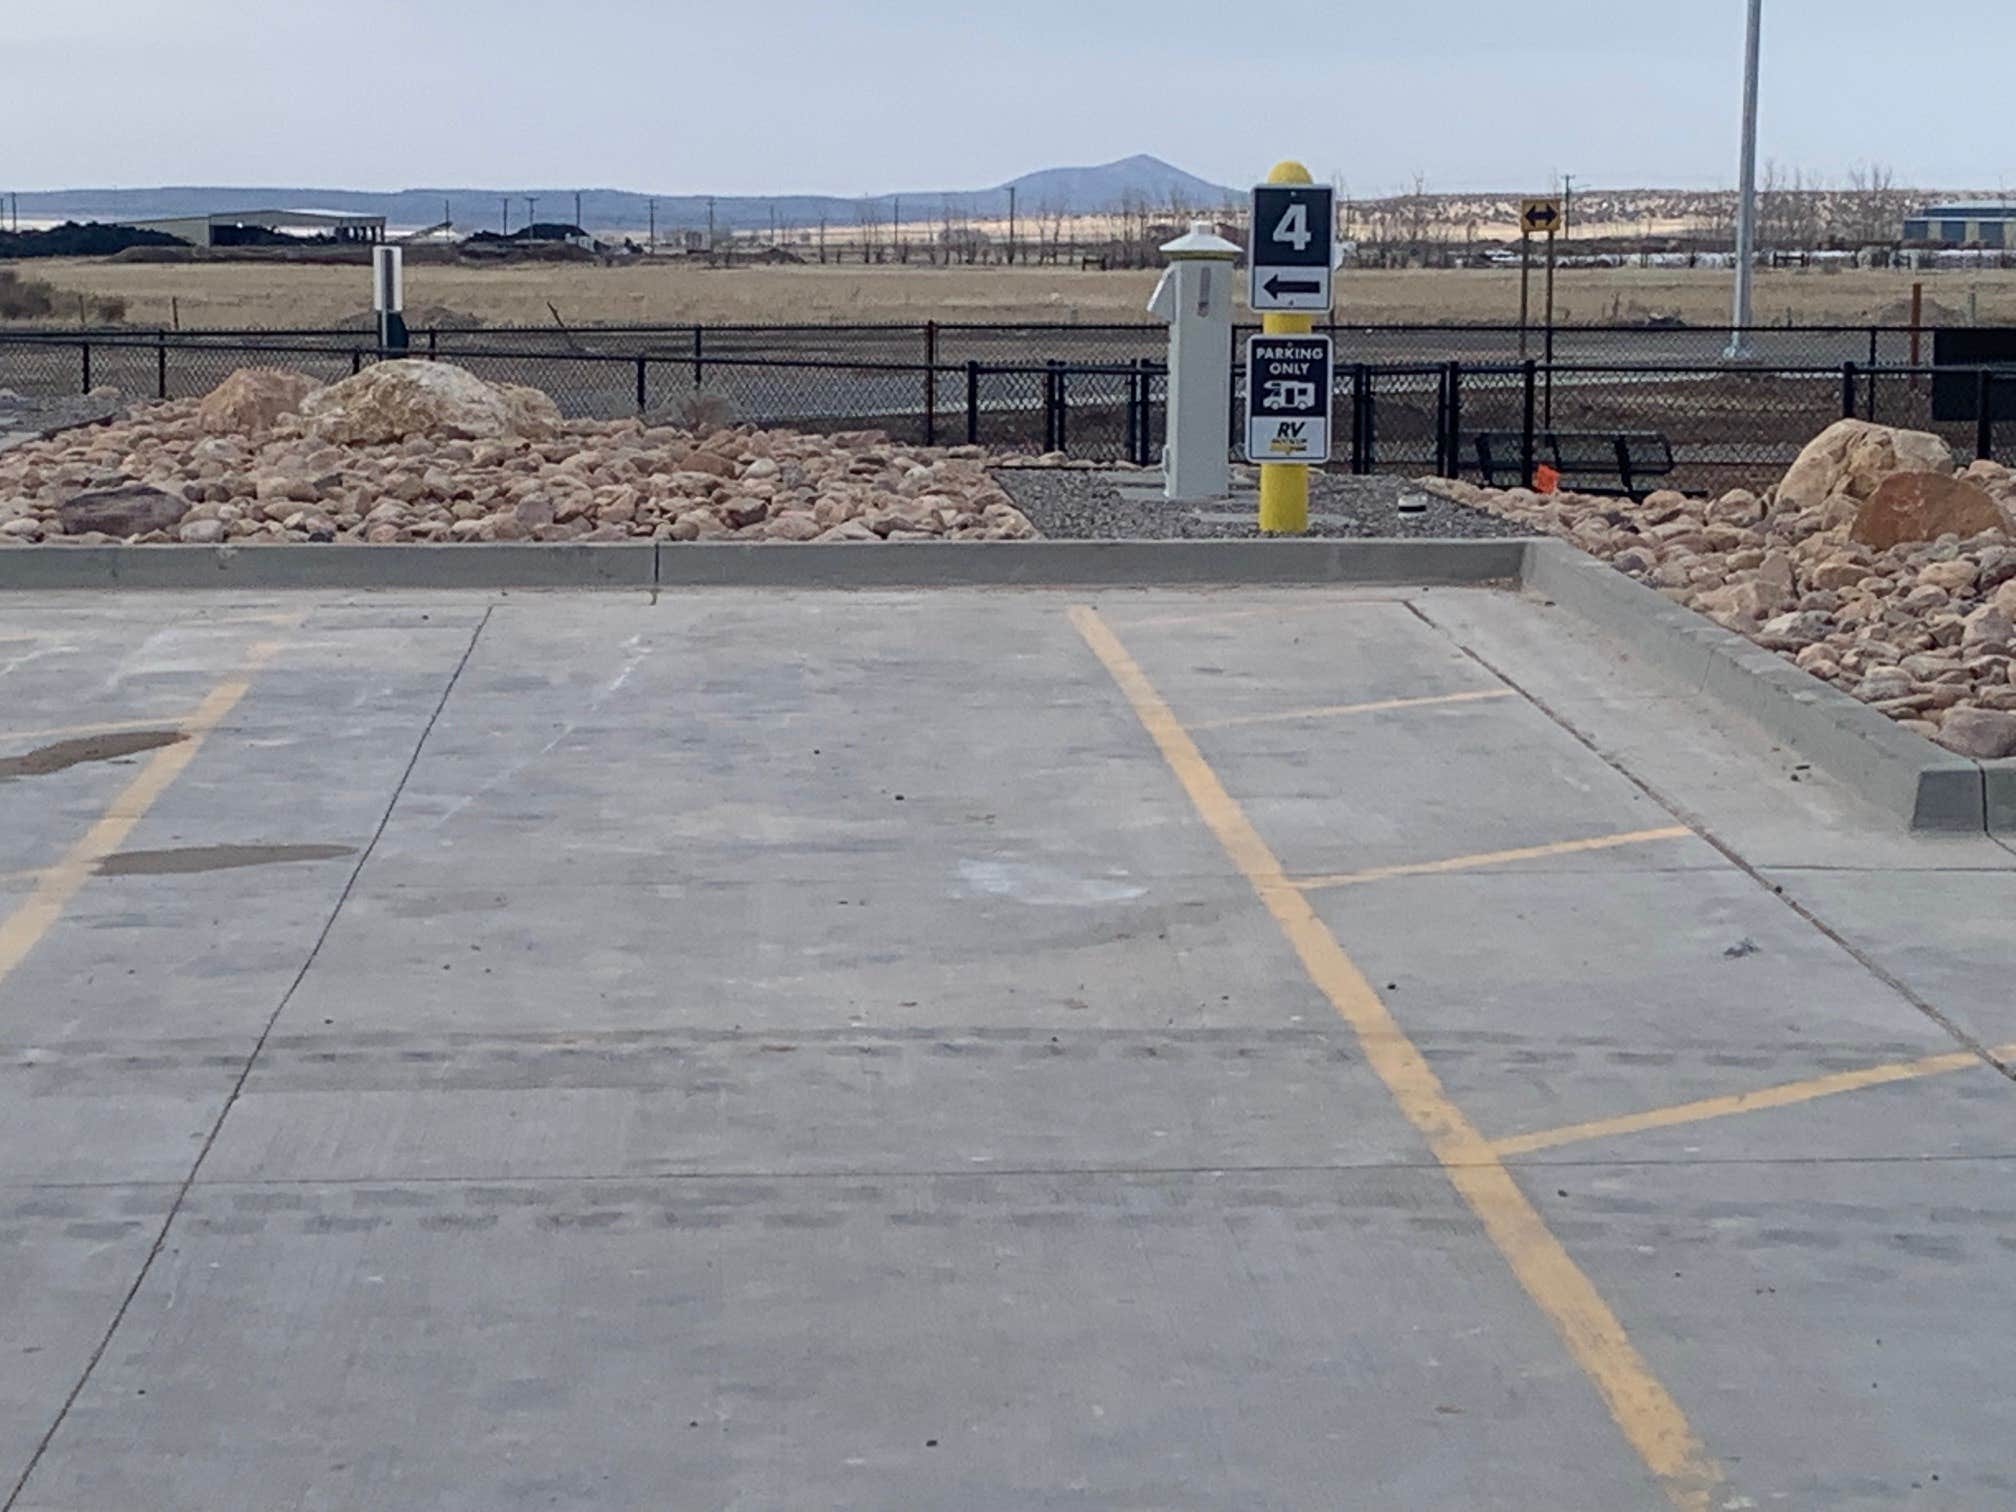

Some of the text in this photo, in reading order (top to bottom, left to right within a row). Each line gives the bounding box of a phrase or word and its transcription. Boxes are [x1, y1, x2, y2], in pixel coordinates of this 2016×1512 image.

[1272, 203, 1312, 250] 4
[1256, 347, 1324, 360] PARKING
[1269, 362, 1310, 375] ONLY
[1277, 422, 1306, 438] RV
